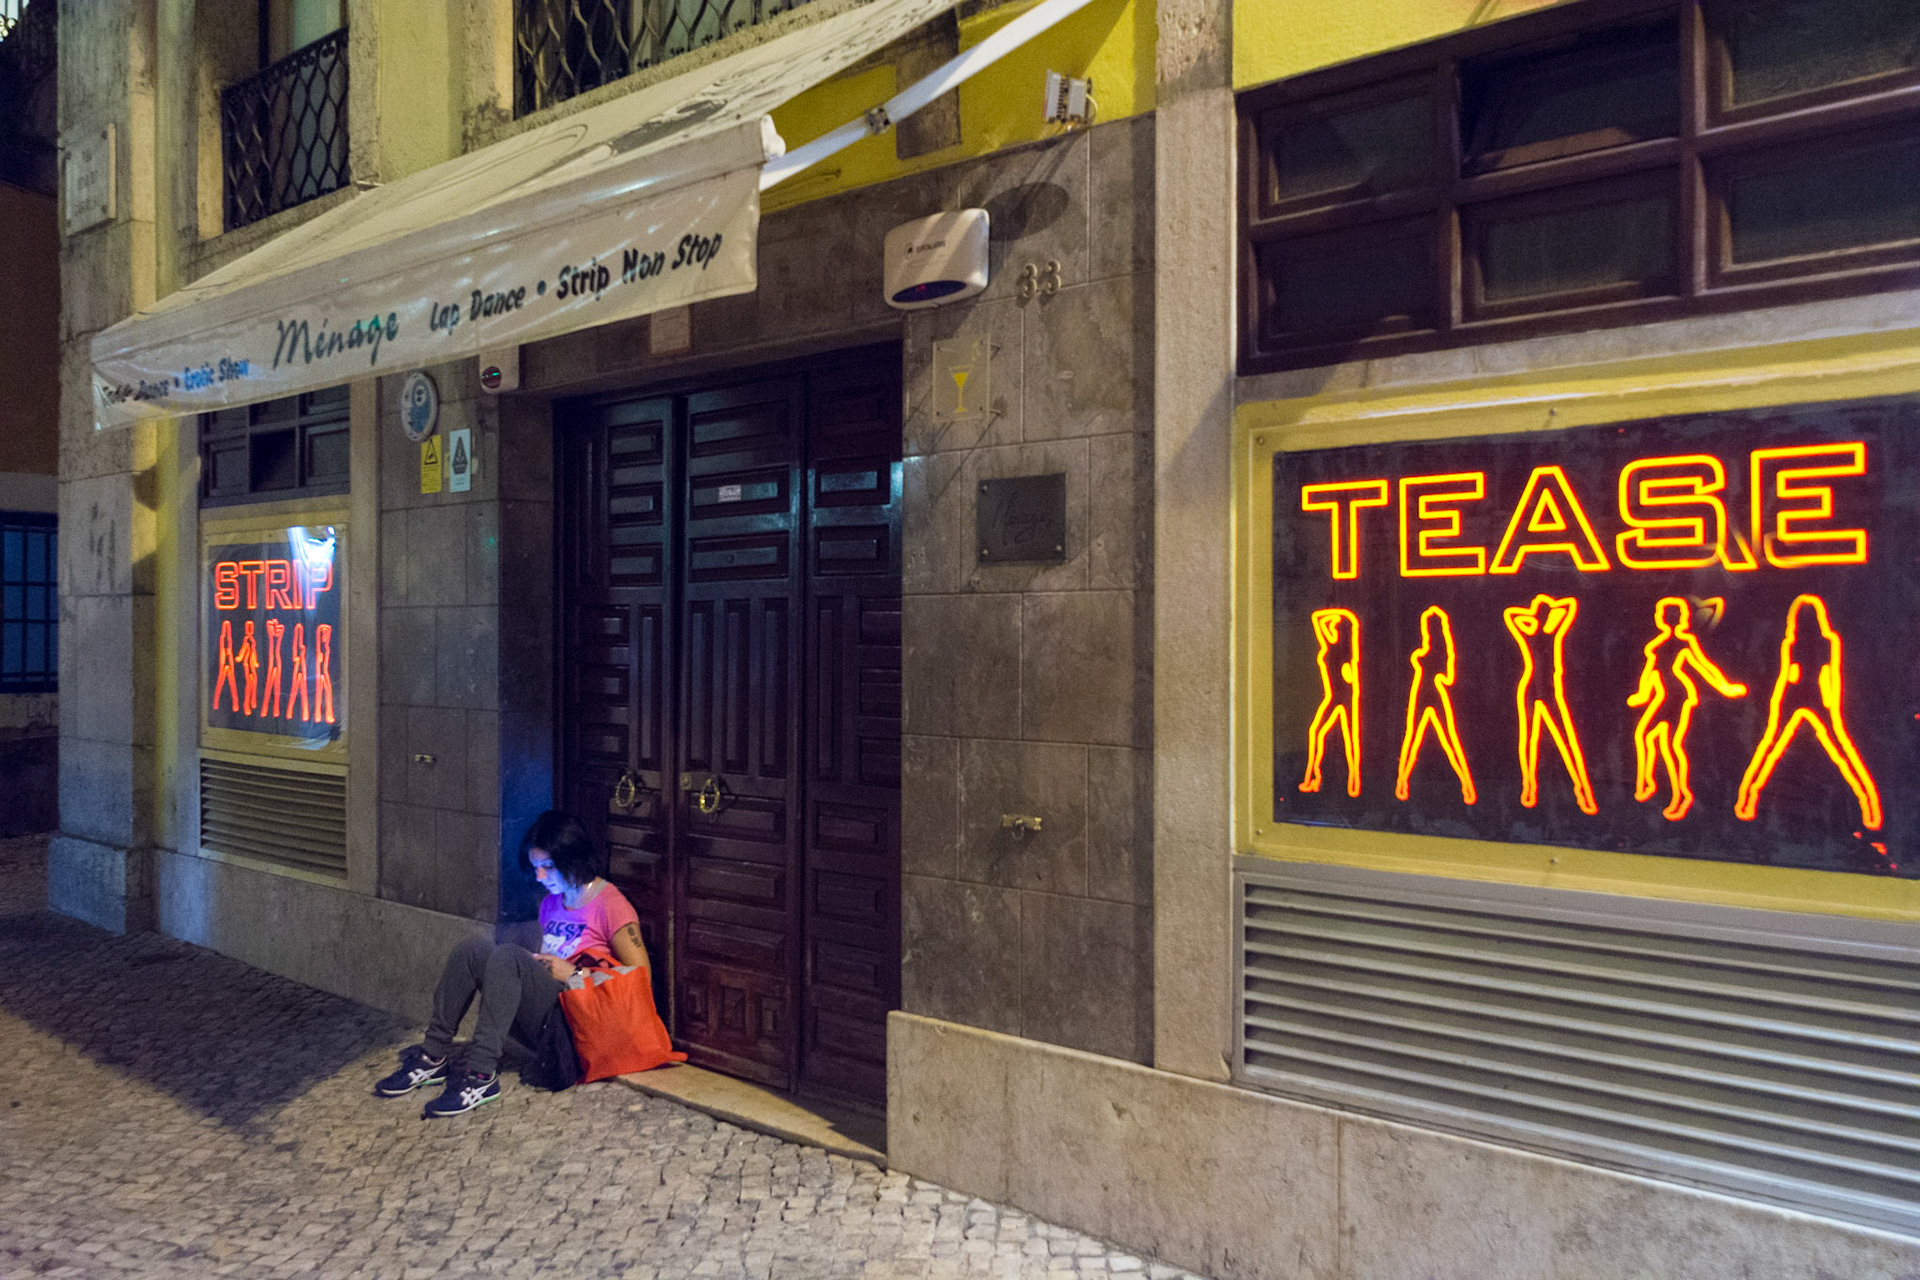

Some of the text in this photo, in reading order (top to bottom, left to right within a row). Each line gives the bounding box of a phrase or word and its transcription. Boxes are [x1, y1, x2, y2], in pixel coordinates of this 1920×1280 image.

[218, 355, 250, 382] Show
[273, 310, 399, 370] Ménage
[430, 301, 460, 336] Lap
[470, 285, 527, 322] Dance
[556, 256, 611, 301] Strip
[622, 247, 666, 285] Non
[672, 232, 723, 270] Stop
[1300, 440, 1869, 581] TEASE
[213, 558, 334, 611] STRIP
